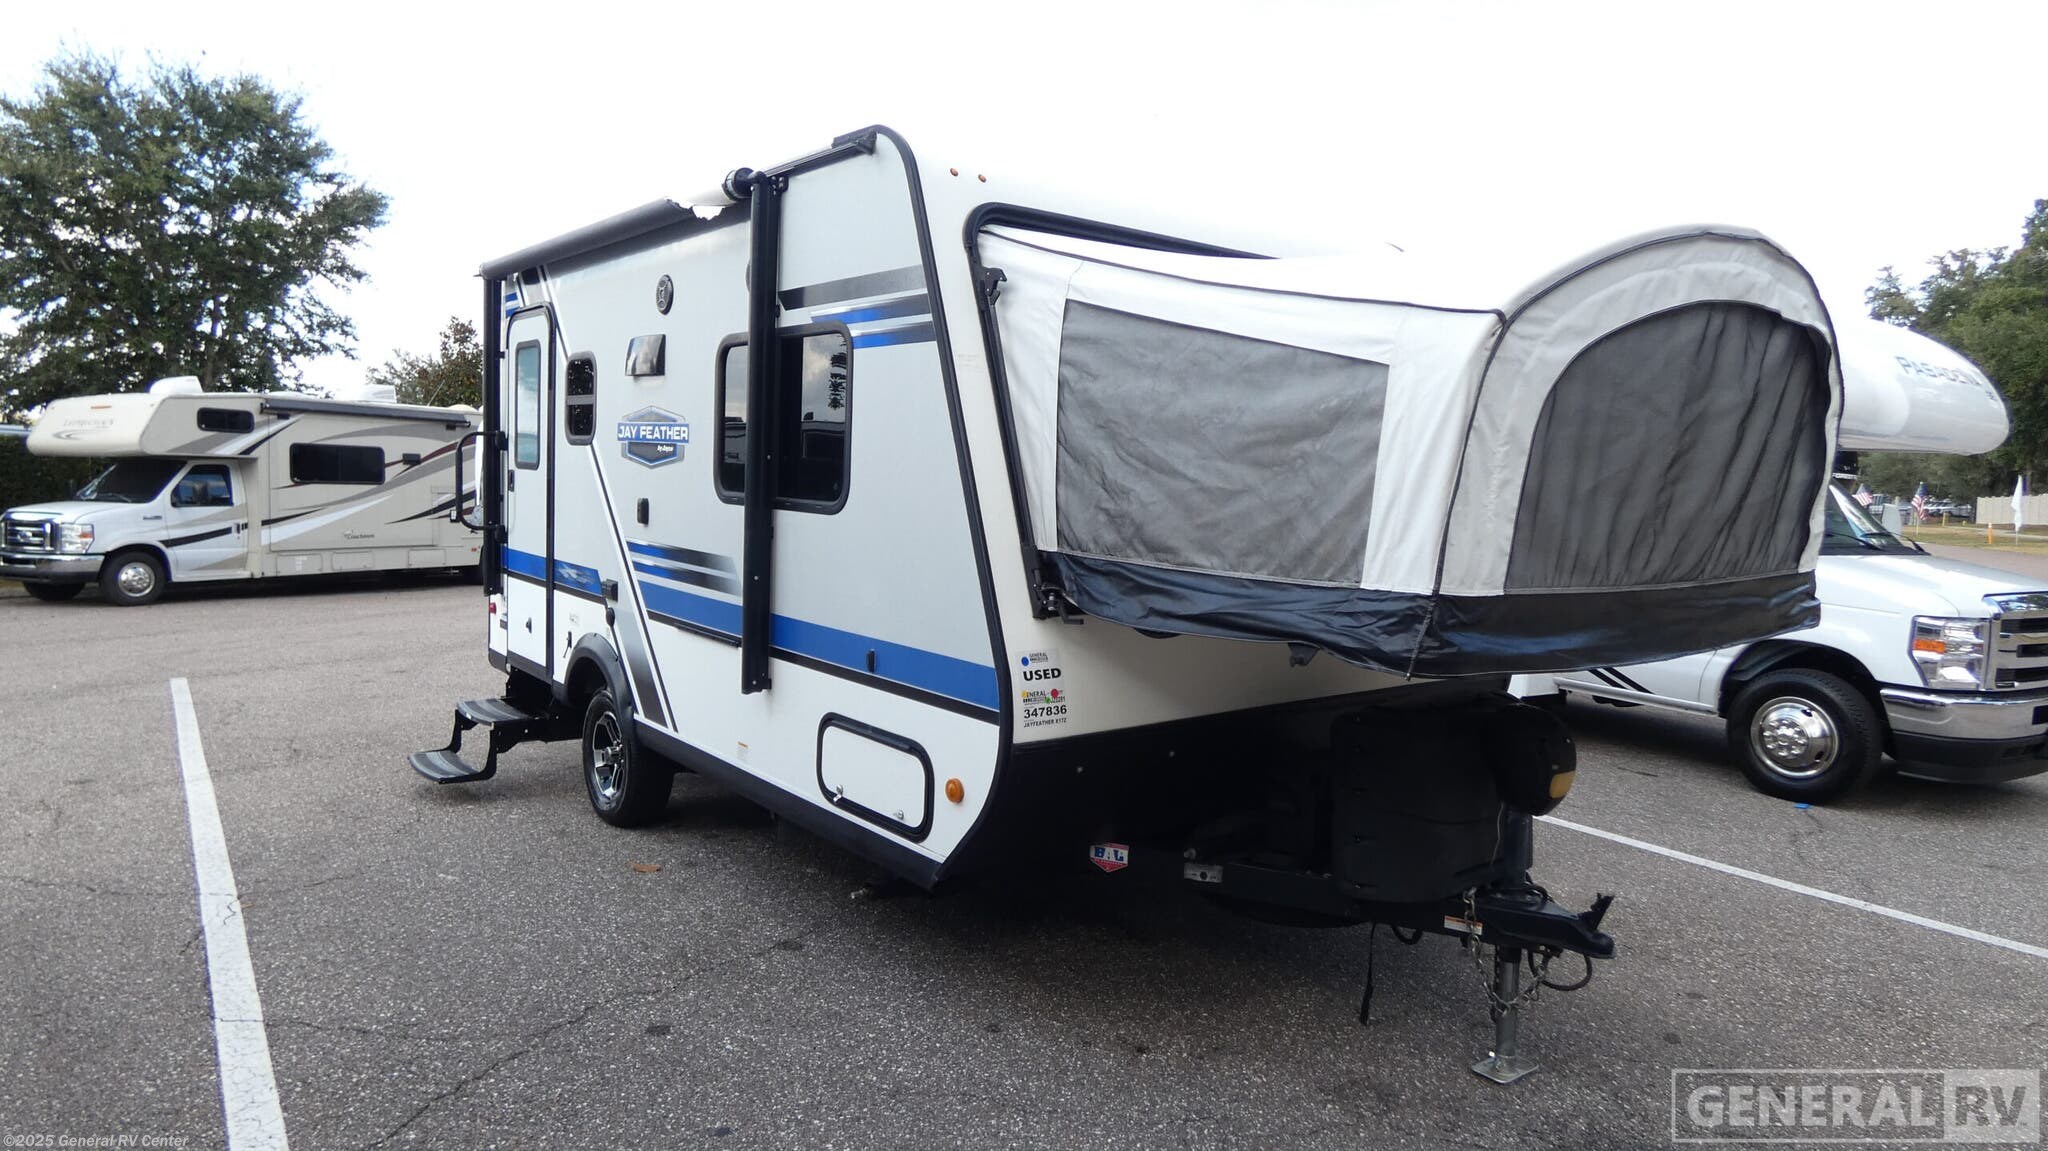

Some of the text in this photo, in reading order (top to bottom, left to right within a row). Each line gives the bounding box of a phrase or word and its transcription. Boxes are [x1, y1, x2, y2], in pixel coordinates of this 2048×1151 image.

[618, 425, 688, 440] JAY FEATHER
[1023, 668, 1061, 681] USED
[1024, 705, 1067, 719] 347836
[1024, 720, 1055, 728] JAYFEATHER
